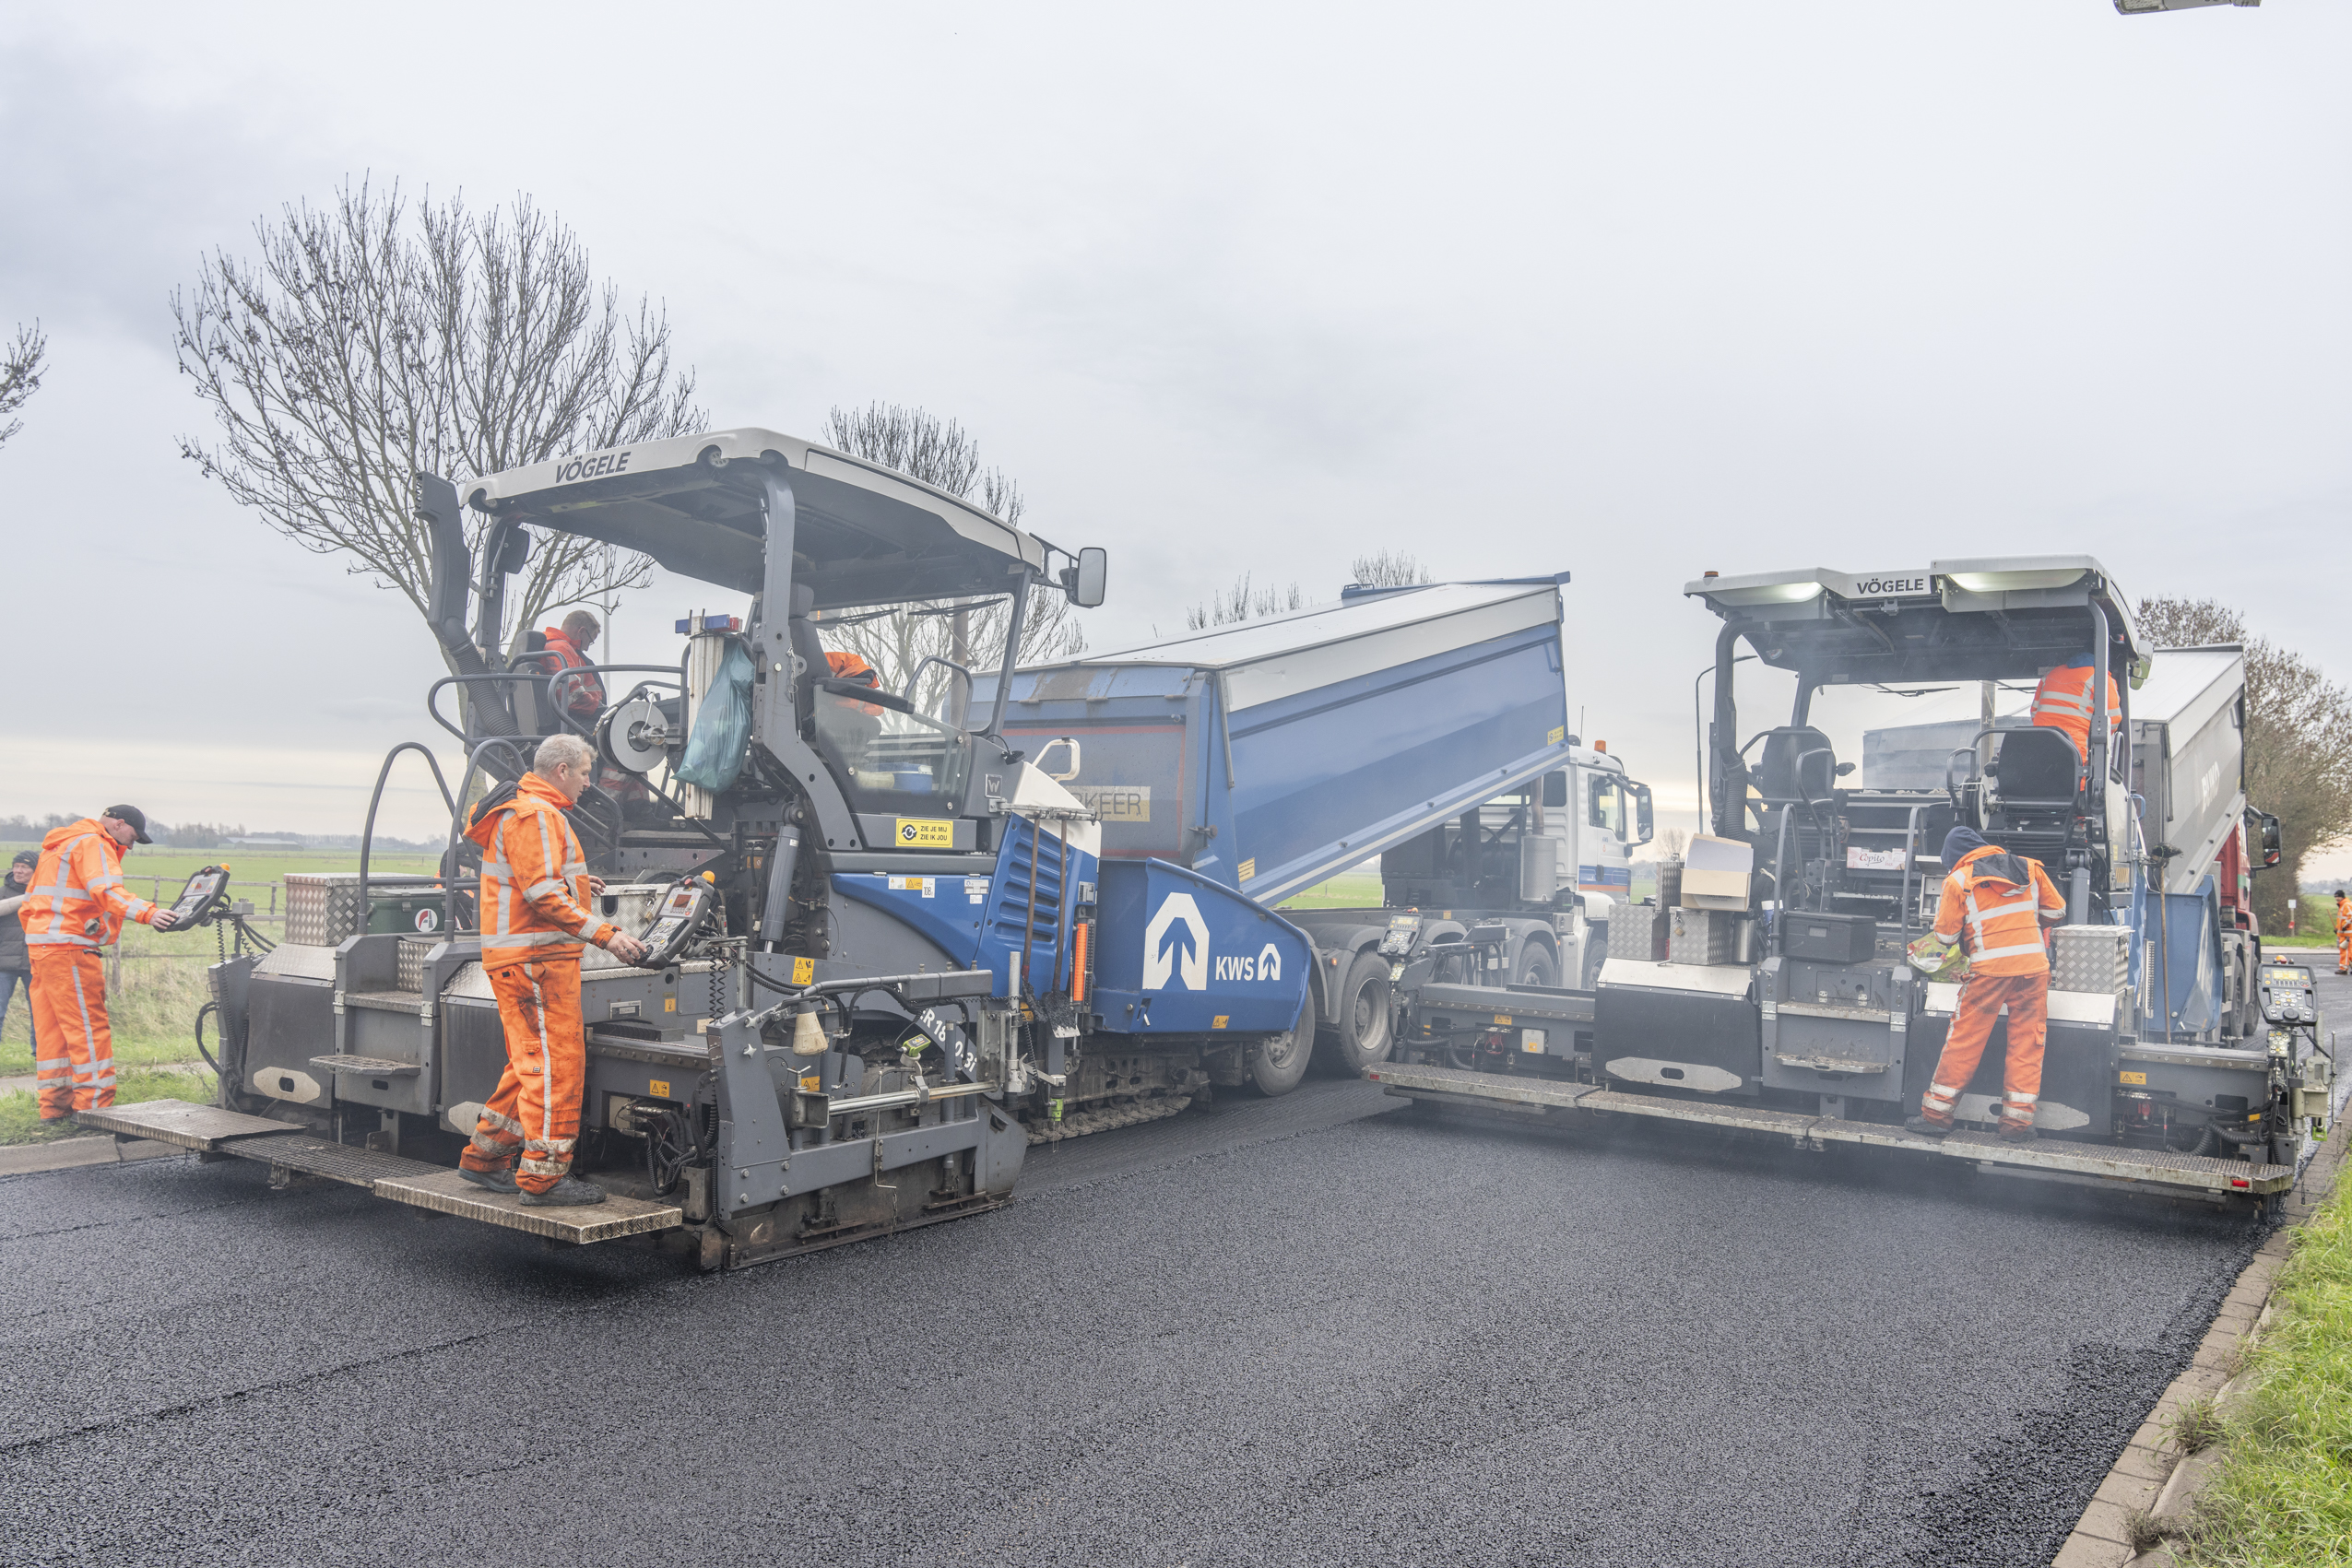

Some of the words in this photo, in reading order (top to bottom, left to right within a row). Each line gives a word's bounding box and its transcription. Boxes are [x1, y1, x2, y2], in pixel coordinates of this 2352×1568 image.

[555, 451, 632, 484] VÖGELE
[1856, 578, 1924, 595] VÖGELE
[923, 886, 932, 896] 108
[1215, 956, 1255, 982] KWS
